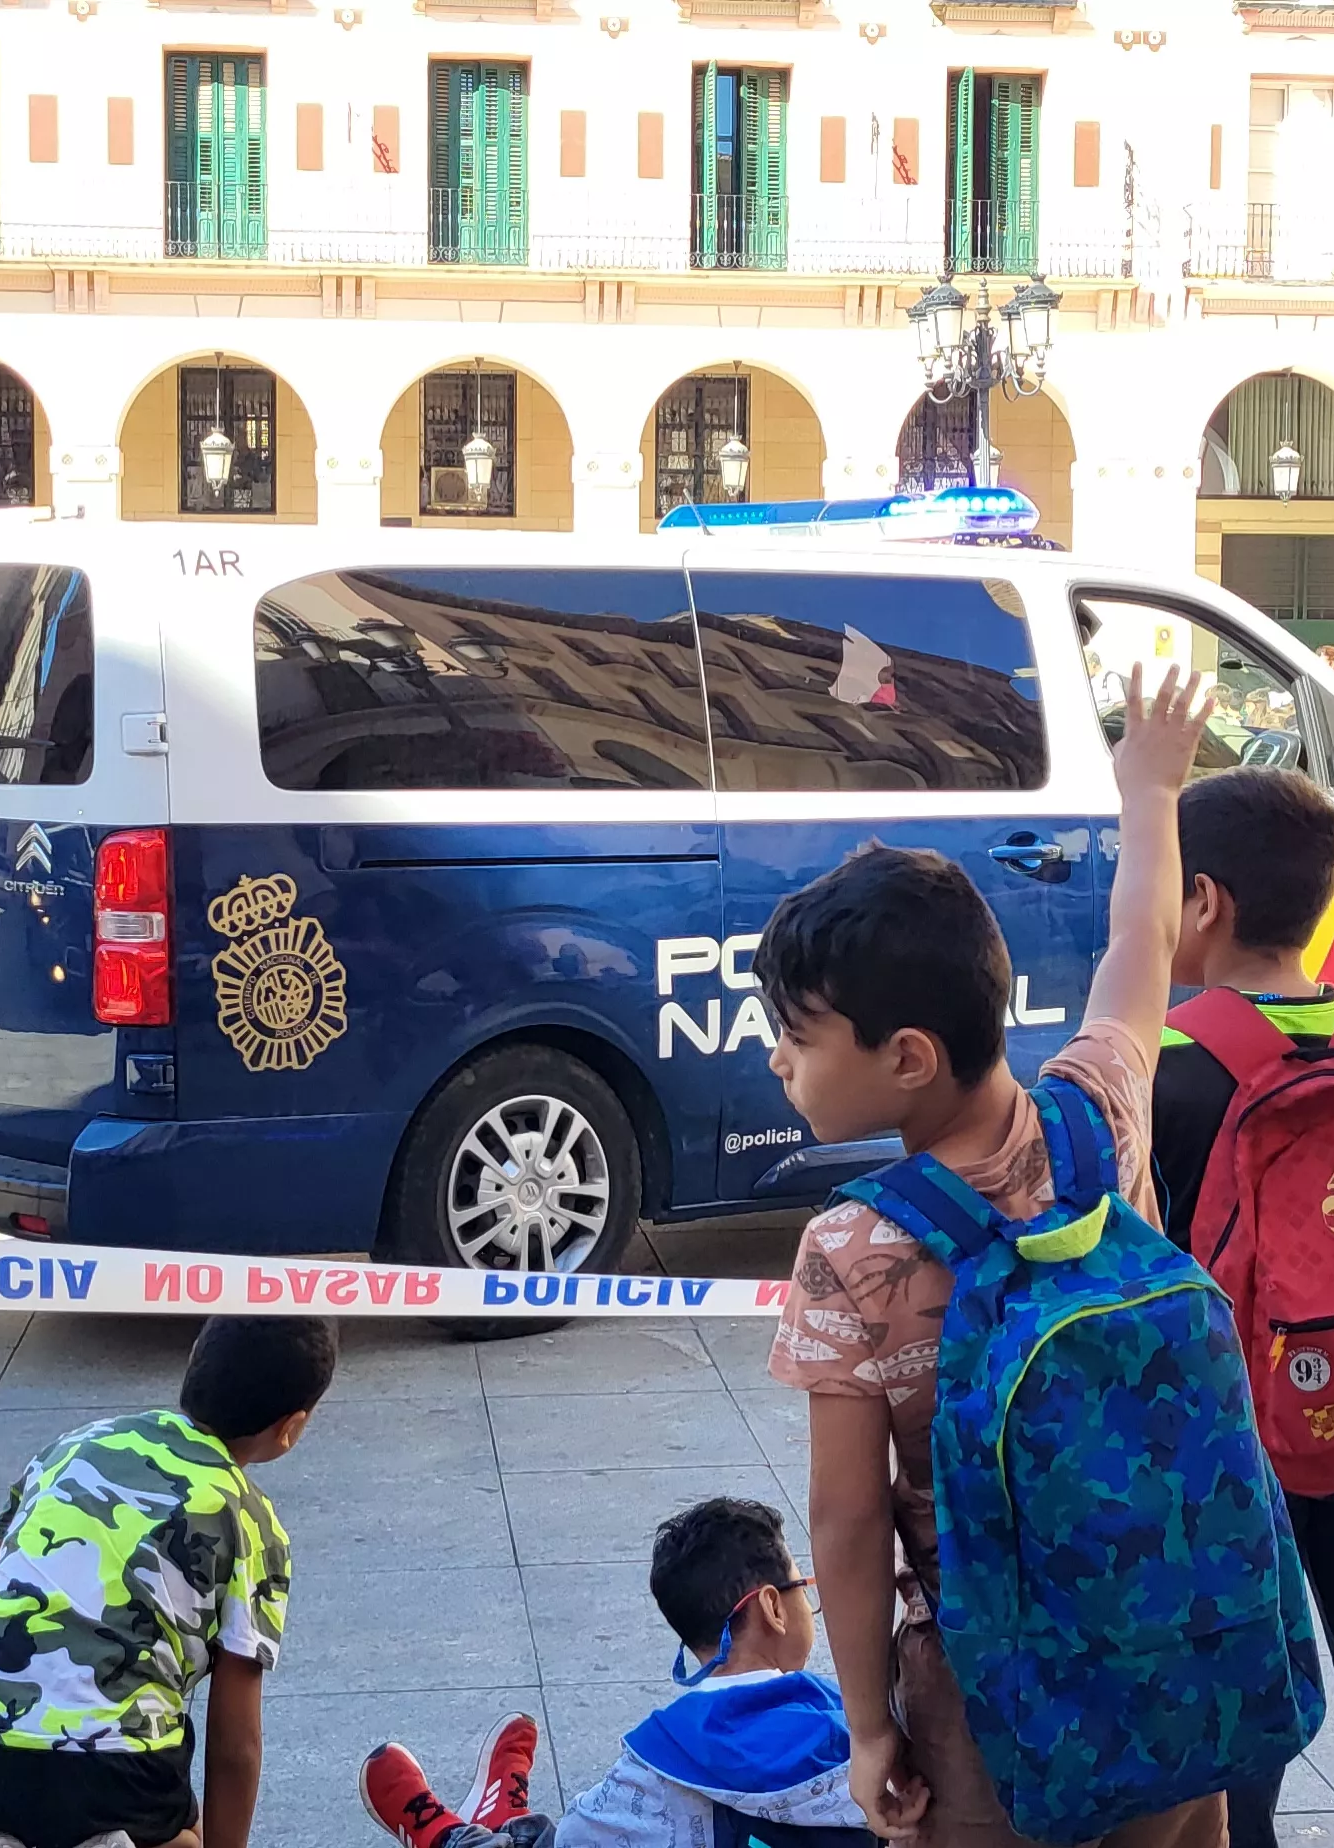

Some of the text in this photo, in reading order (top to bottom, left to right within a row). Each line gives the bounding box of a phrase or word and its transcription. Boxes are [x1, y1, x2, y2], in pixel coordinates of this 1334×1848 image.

[172, 549, 244, 577] 1AR
[259, 955, 305, 972] NACIONAL
[307, 971, 320, 985] DE
[724, 1126, 802, 1154] @policia
